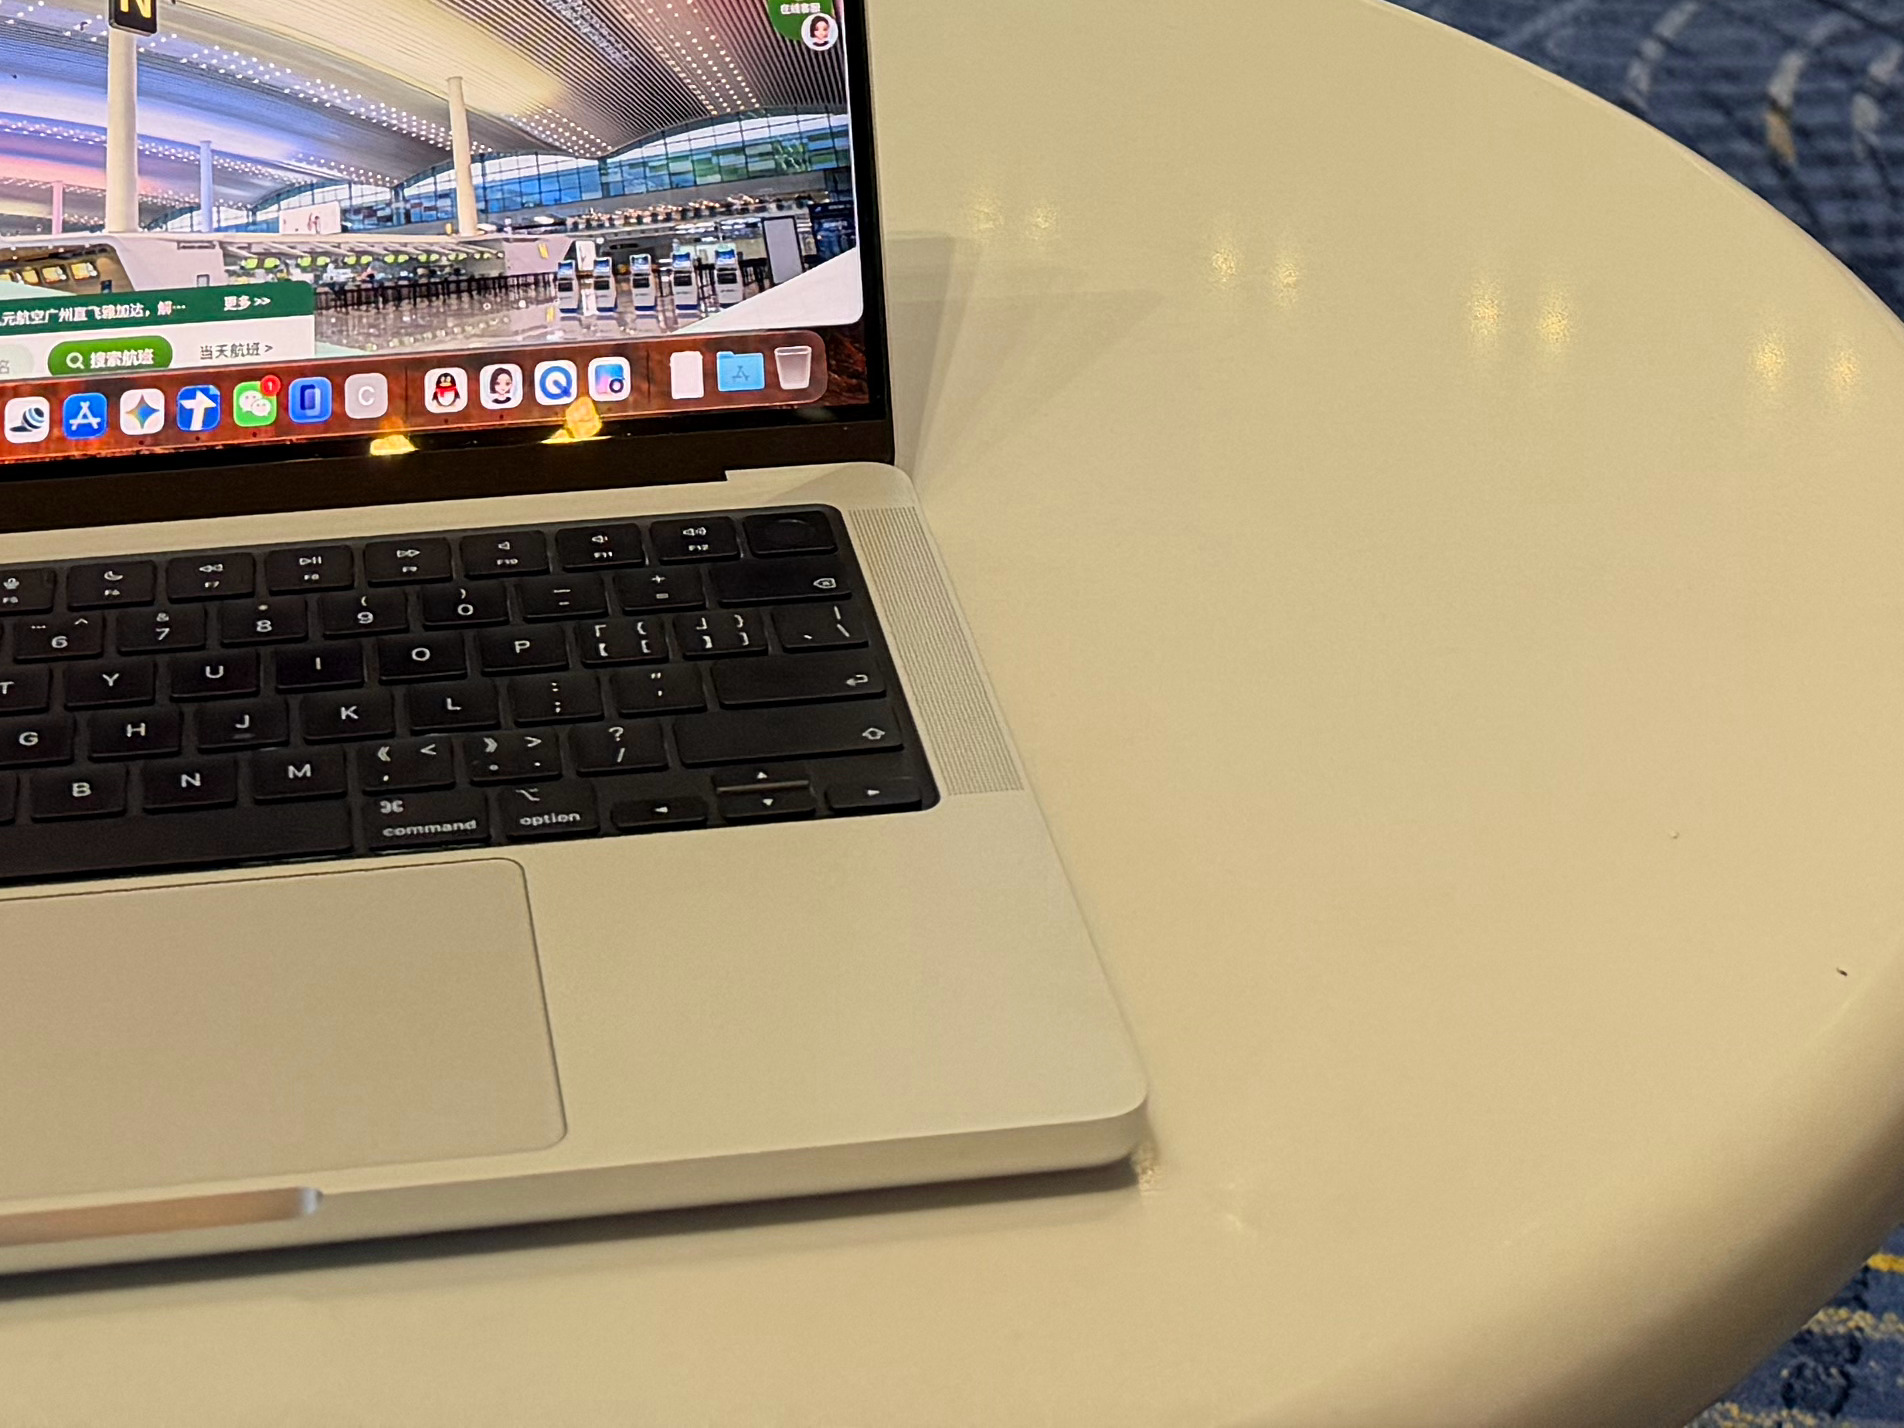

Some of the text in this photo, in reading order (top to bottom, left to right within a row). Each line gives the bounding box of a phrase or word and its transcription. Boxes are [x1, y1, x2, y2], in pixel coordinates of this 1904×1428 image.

[223, 296, 251, 312] 更多
[90, 348, 154, 369] 搜索航班
[200, 343, 260, 361] 当天航班
[357, 610, 374, 624] 9
[155, 626, 171, 640] 7
[255, 619, 273, 633] 8
[51, 635, 69, 649] 6
[514, 639, 531, 654] P
[411, 646, 431, 662] O
[102, 672, 120, 686] Y
[204, 664, 224, 679] U
[446, 697, 462, 711] L
[340, 705, 359, 720] K
[234, 714, 251, 729] J
[126, 722, 146, 738] H
[18, 731, 39, 746] G
[287, 763, 312, 779] M
[180, 772, 202, 788] N
[71, 781, 92, 797] B
[519, 811, 582, 827] option
[382, 818, 478, 838] command
